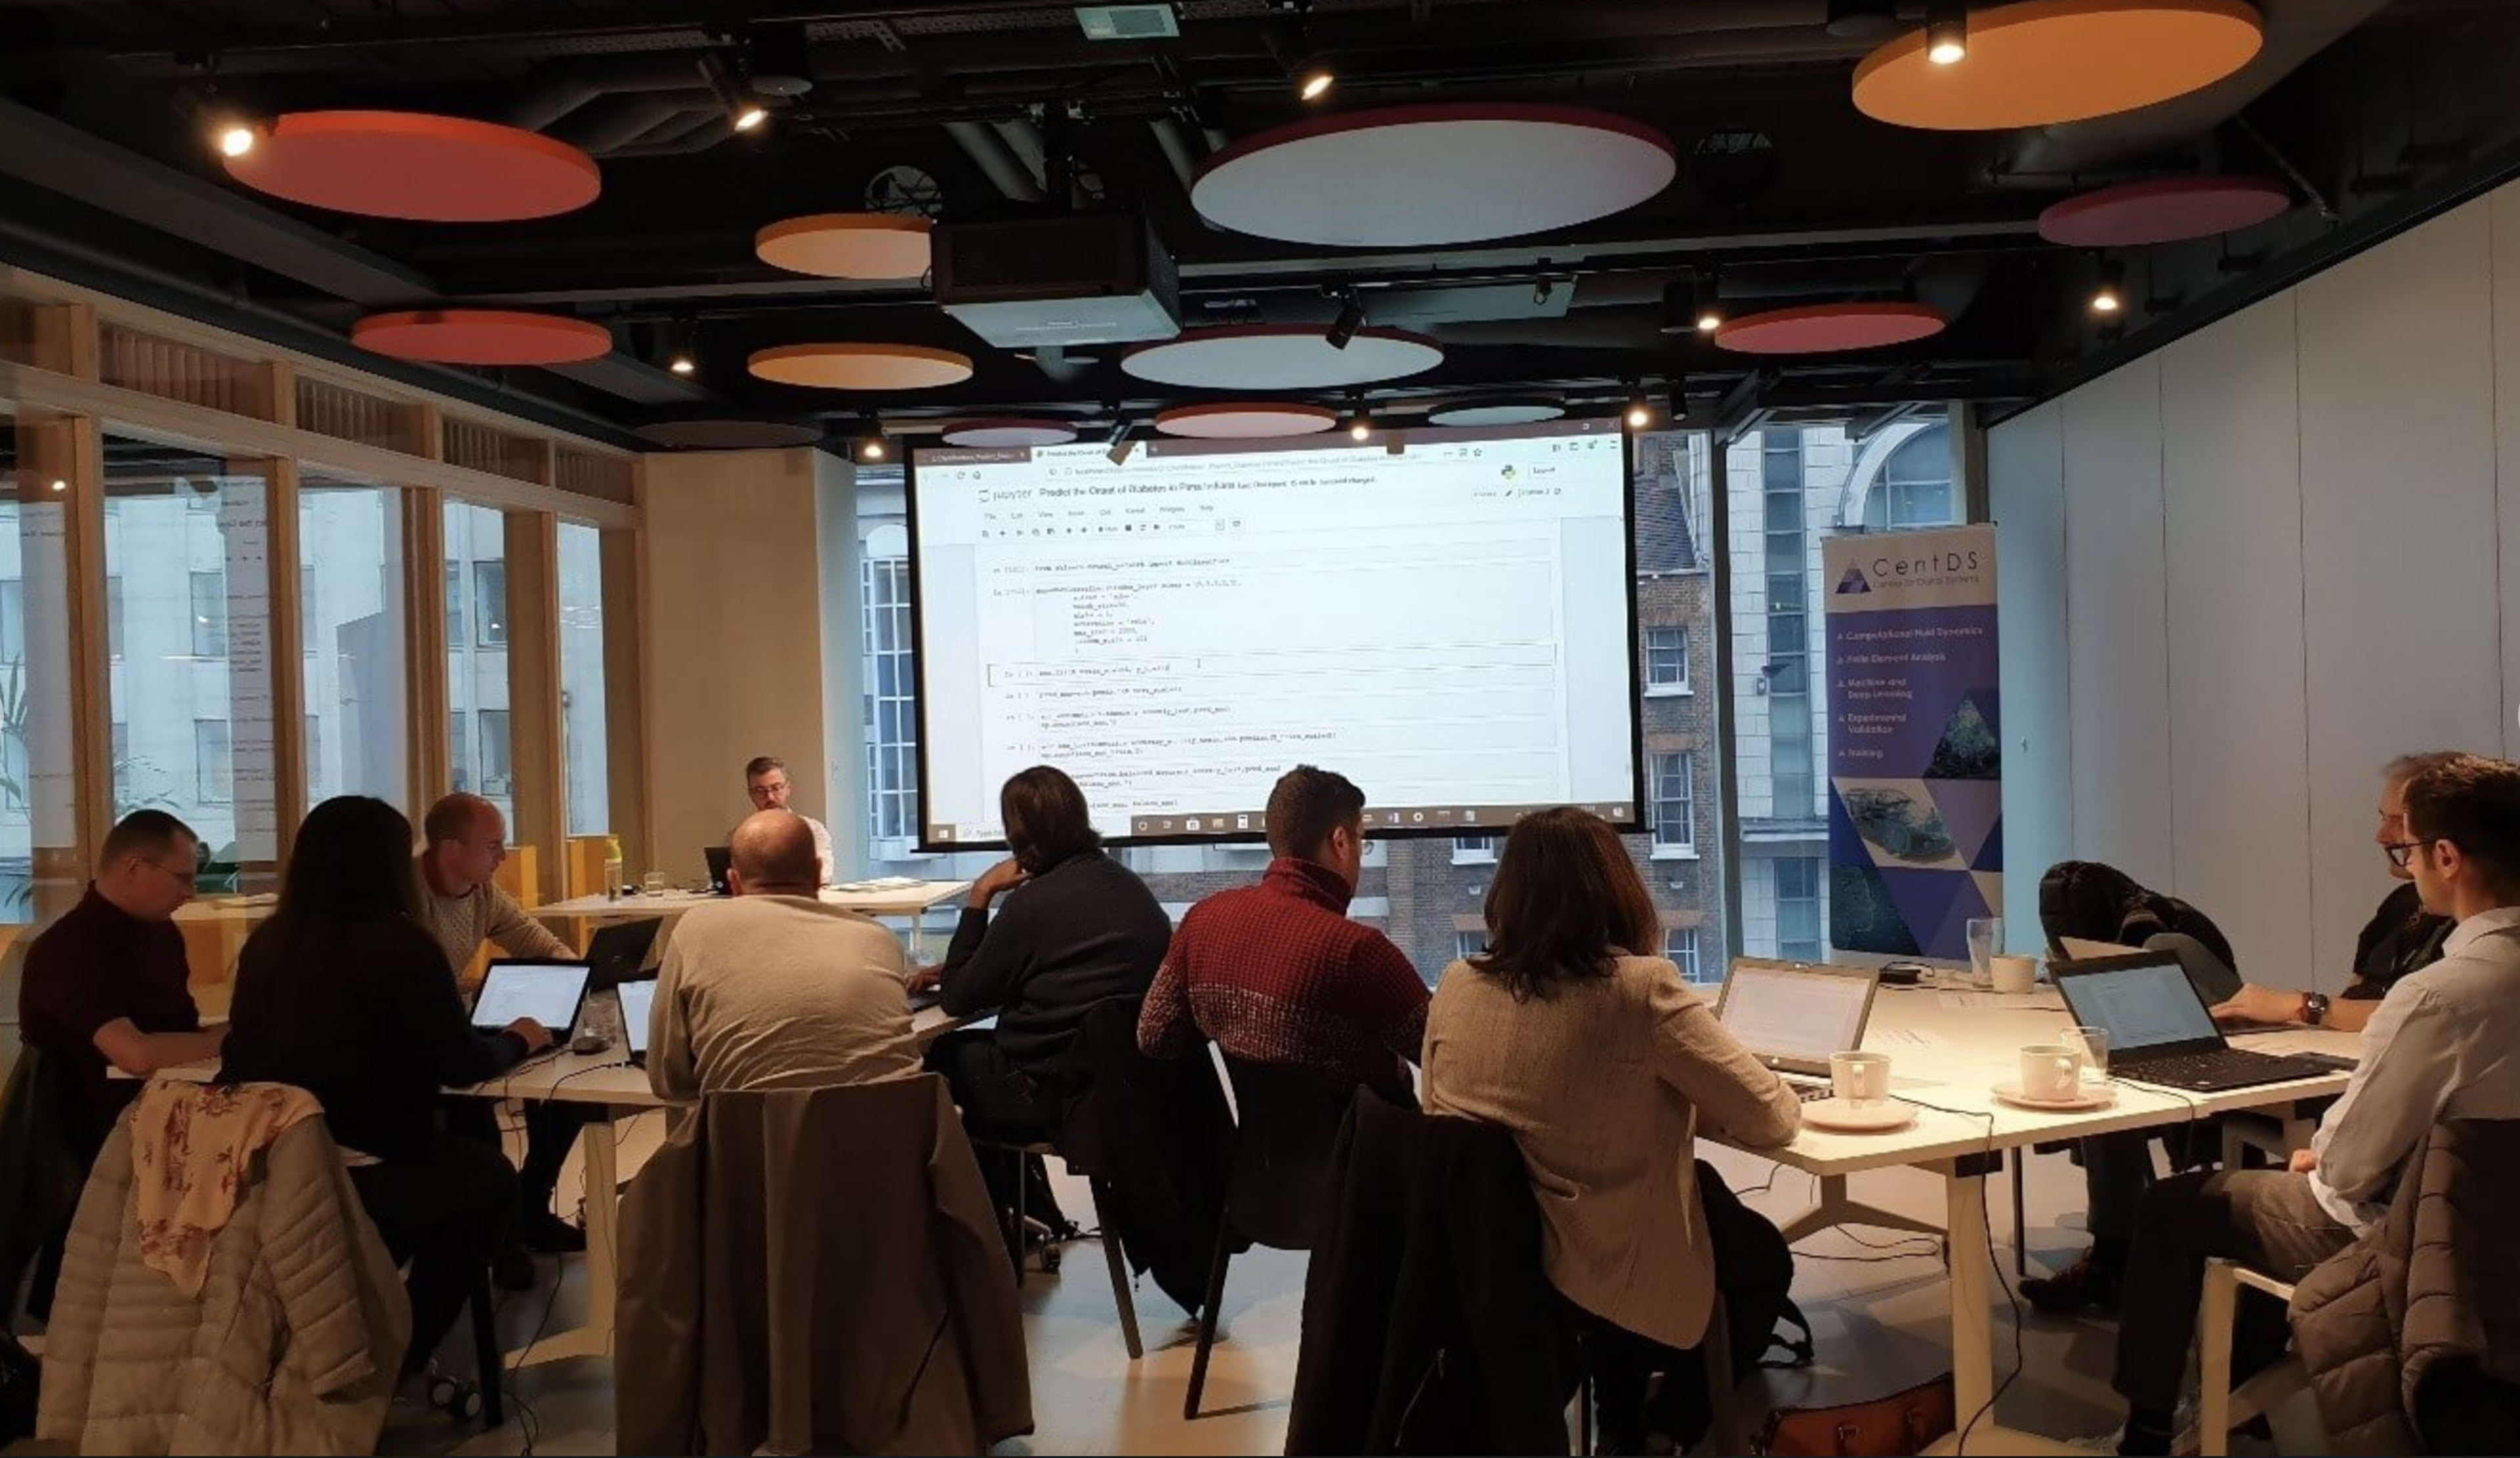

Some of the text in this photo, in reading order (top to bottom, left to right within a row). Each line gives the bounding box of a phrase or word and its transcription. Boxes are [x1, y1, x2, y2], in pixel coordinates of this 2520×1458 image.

[1038, 487, 1070, 497] Predict
[1073, 487, 1085, 497] the
[1088, 485, 1116, 496] Onset
[1117, 484, 1126, 494] of
[1128, 483, 1166, 494] Diabetes
[1169, 483, 1178, 492] in
[1872, 550, 1978, 578] CentDS
[1846, 626, 1983, 641] Computational Fluid Dynamics
[1871, 654, 1908, 664] Element
[1911, 653, 1946, 662] Analysis
[1848, 678, 1906, 687] Machine and
[1848, 689, 1912, 700] Deep Learning
[1848, 713, 1906, 724] Experimental
[1848, 725, 1893, 734] Validation
[1848, 748, 1883, 760] Training
